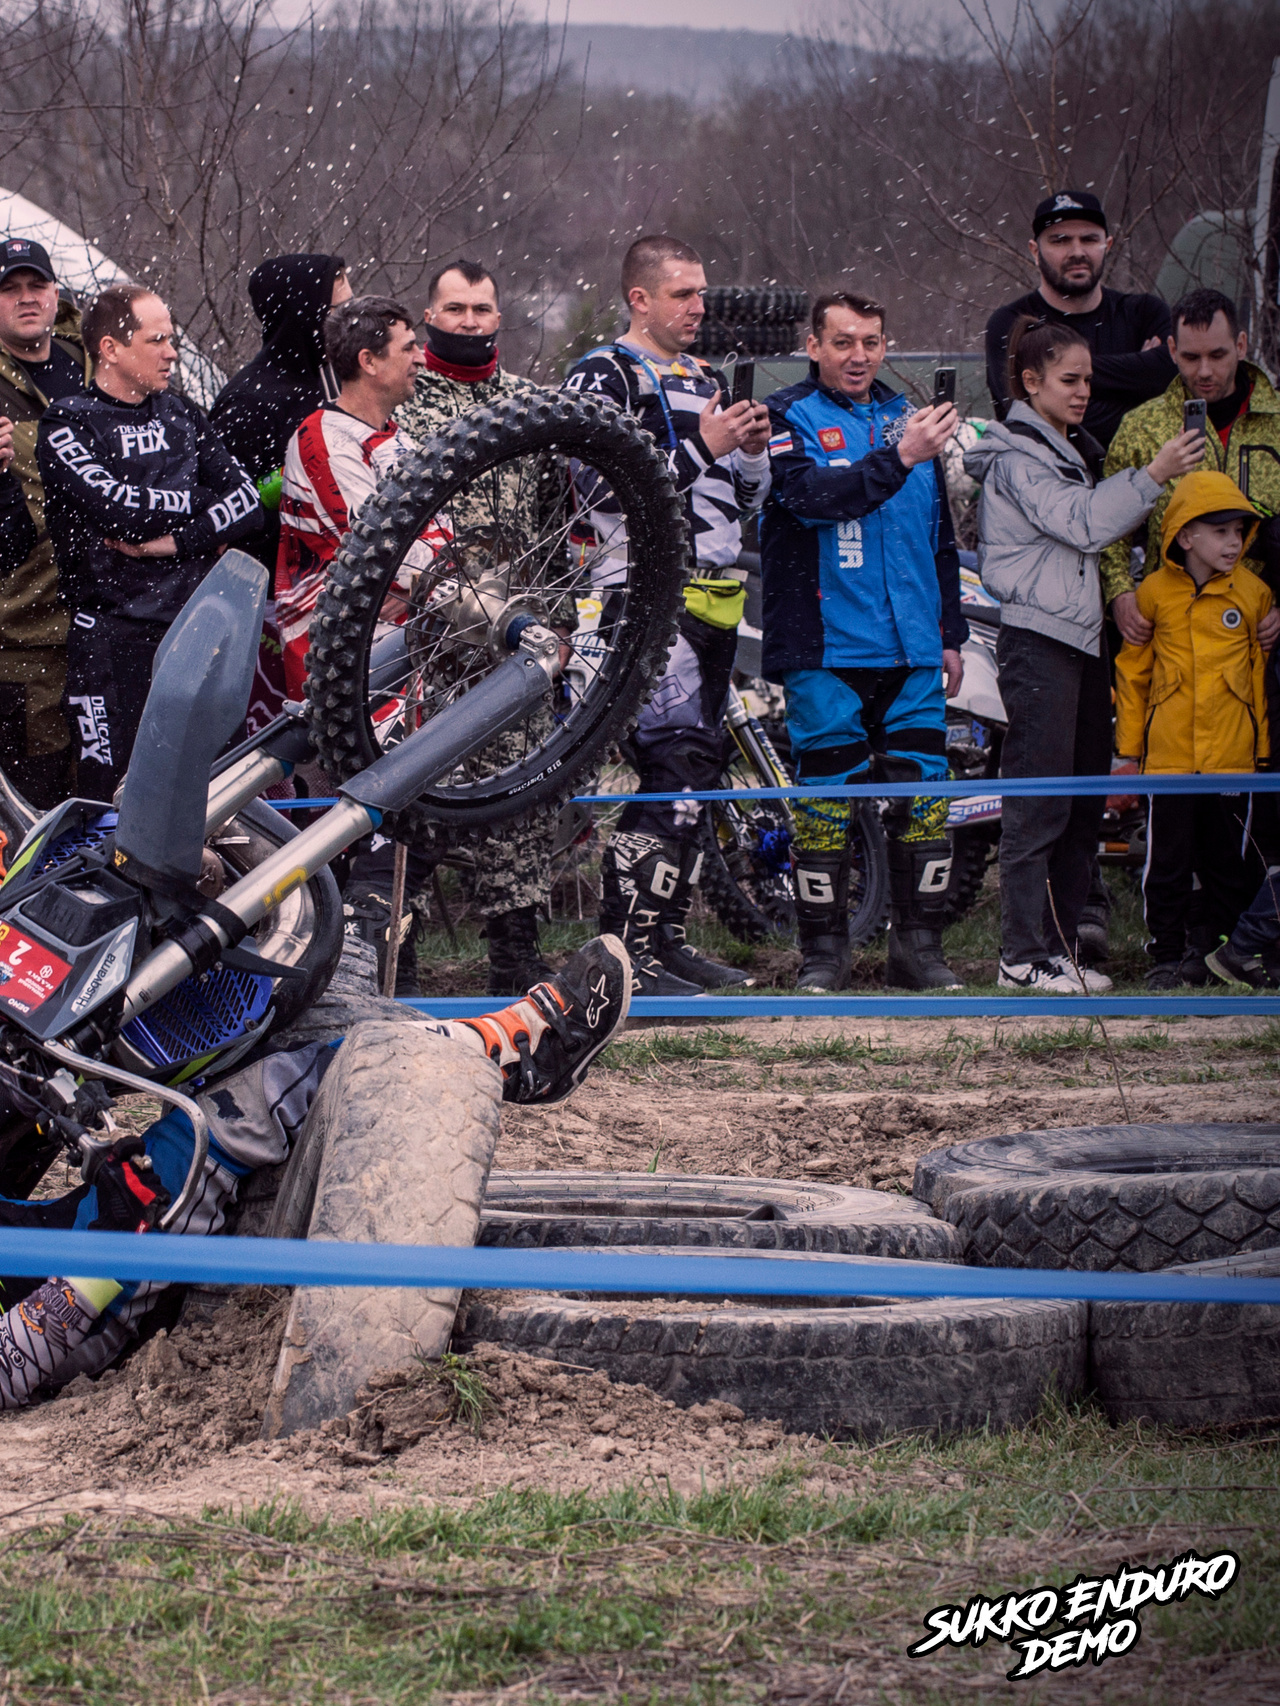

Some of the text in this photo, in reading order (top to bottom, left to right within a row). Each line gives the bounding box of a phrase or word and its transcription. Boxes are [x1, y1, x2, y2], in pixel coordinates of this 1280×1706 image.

[119, 419, 165, 435] DELICATE
[121, 427, 170, 459] FOX
[47, 426, 192, 515] DELICATE FOX
[69, 696, 107, 765] FOX
[91, 696, 113, 766] DELICATE
[797, 868, 834, 904] G
[917, 857, 953, 892] G
[8, 939, 32, 966] 2
[75, 953, 116, 1008] Husqvarna
[8, 997, 31, 1014] DEMO
